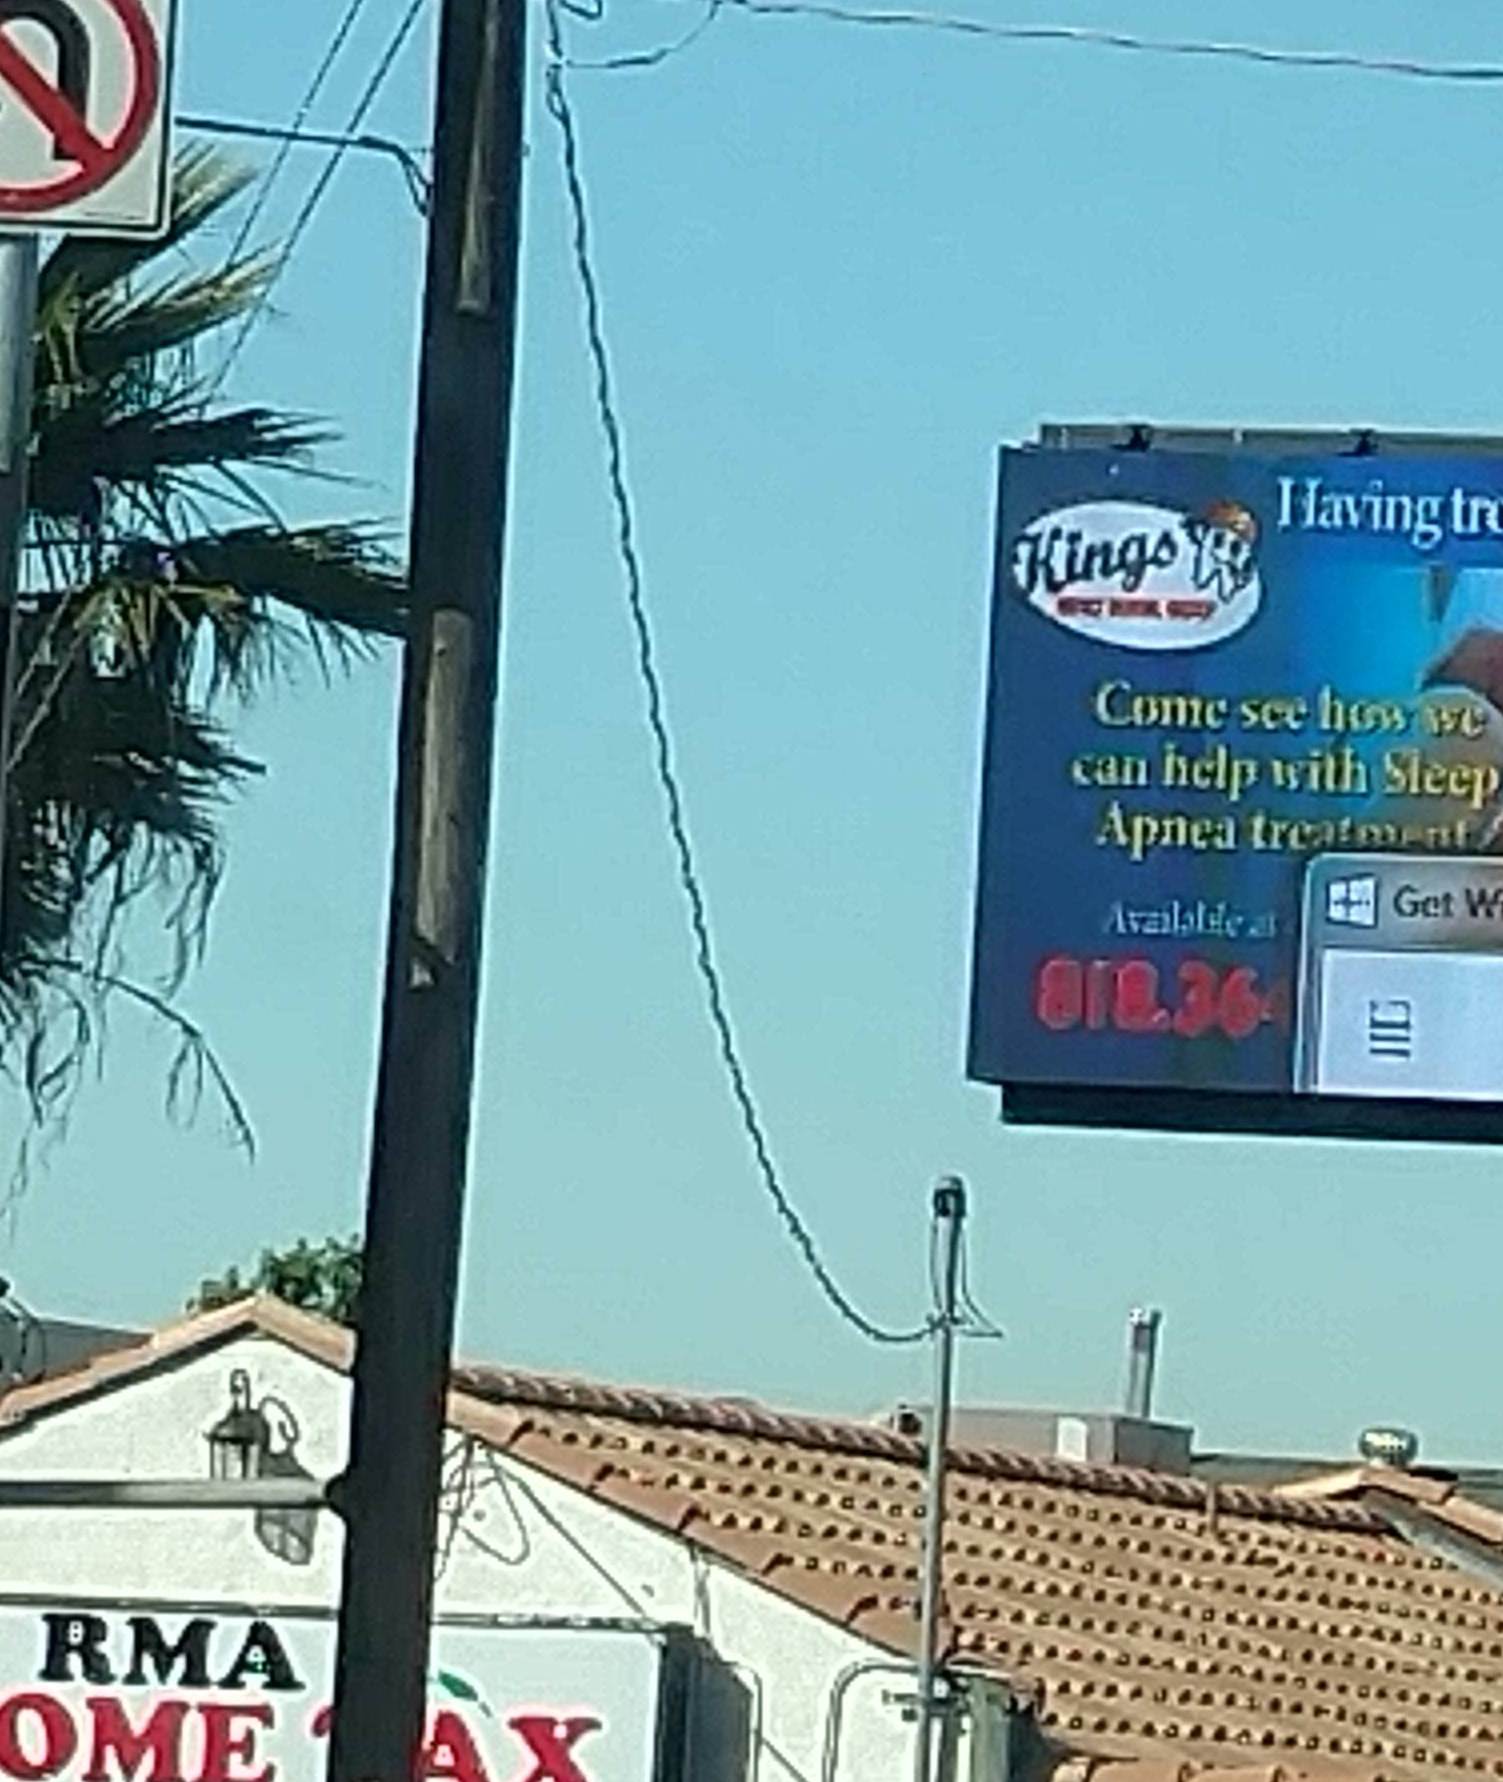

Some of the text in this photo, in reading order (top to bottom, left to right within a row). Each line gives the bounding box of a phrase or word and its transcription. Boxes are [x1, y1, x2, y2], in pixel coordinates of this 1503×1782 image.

[1277, 475, 1444, 549] Having
[1014, 527, 1178, 593] Kings
[1096, 681, 1484, 736] Come see how we
[1072, 742, 1499, 809] can help with Sleep
[1096, 801, 1470, 861] Apnea treatment
[1102, 899, 1244, 938] Available
[1393, 885, 1454, 919] Get
[38, 1613, 306, 1691] RMA
